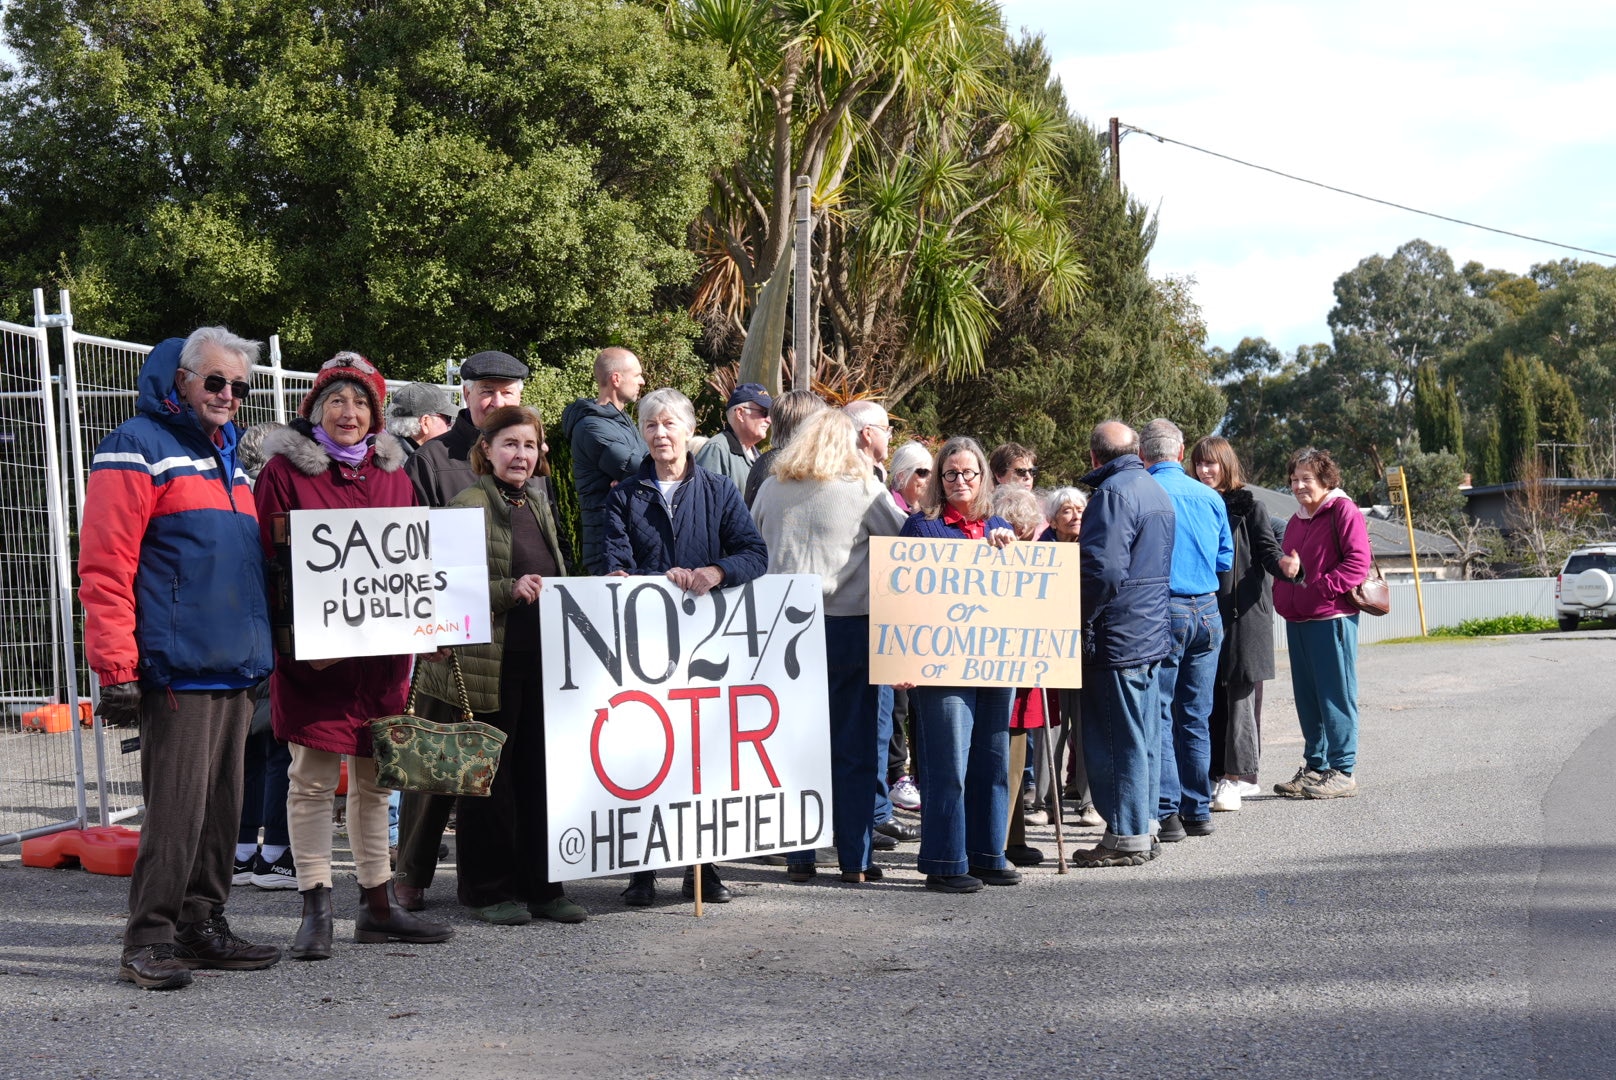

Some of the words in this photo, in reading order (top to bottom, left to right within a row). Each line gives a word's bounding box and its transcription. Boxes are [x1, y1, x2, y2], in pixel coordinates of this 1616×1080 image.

[889, 541, 963, 563] GOVT
[972, 543, 1063, 568] PANEL
[342, 571, 447, 597] IGNORES
[889, 566, 1058, 600] CORRUPT
[323, 596, 432, 627] PUBLIC
[947, 602, 989, 623] or
[874, 624, 1081, 659] INCOMPETENT
[921, 663, 948, 679] or
[590, 684, 781, 801] OTR
[558, 789, 824, 872] @HEATHFIELD
[271, 865, 292, 876] HOKA
